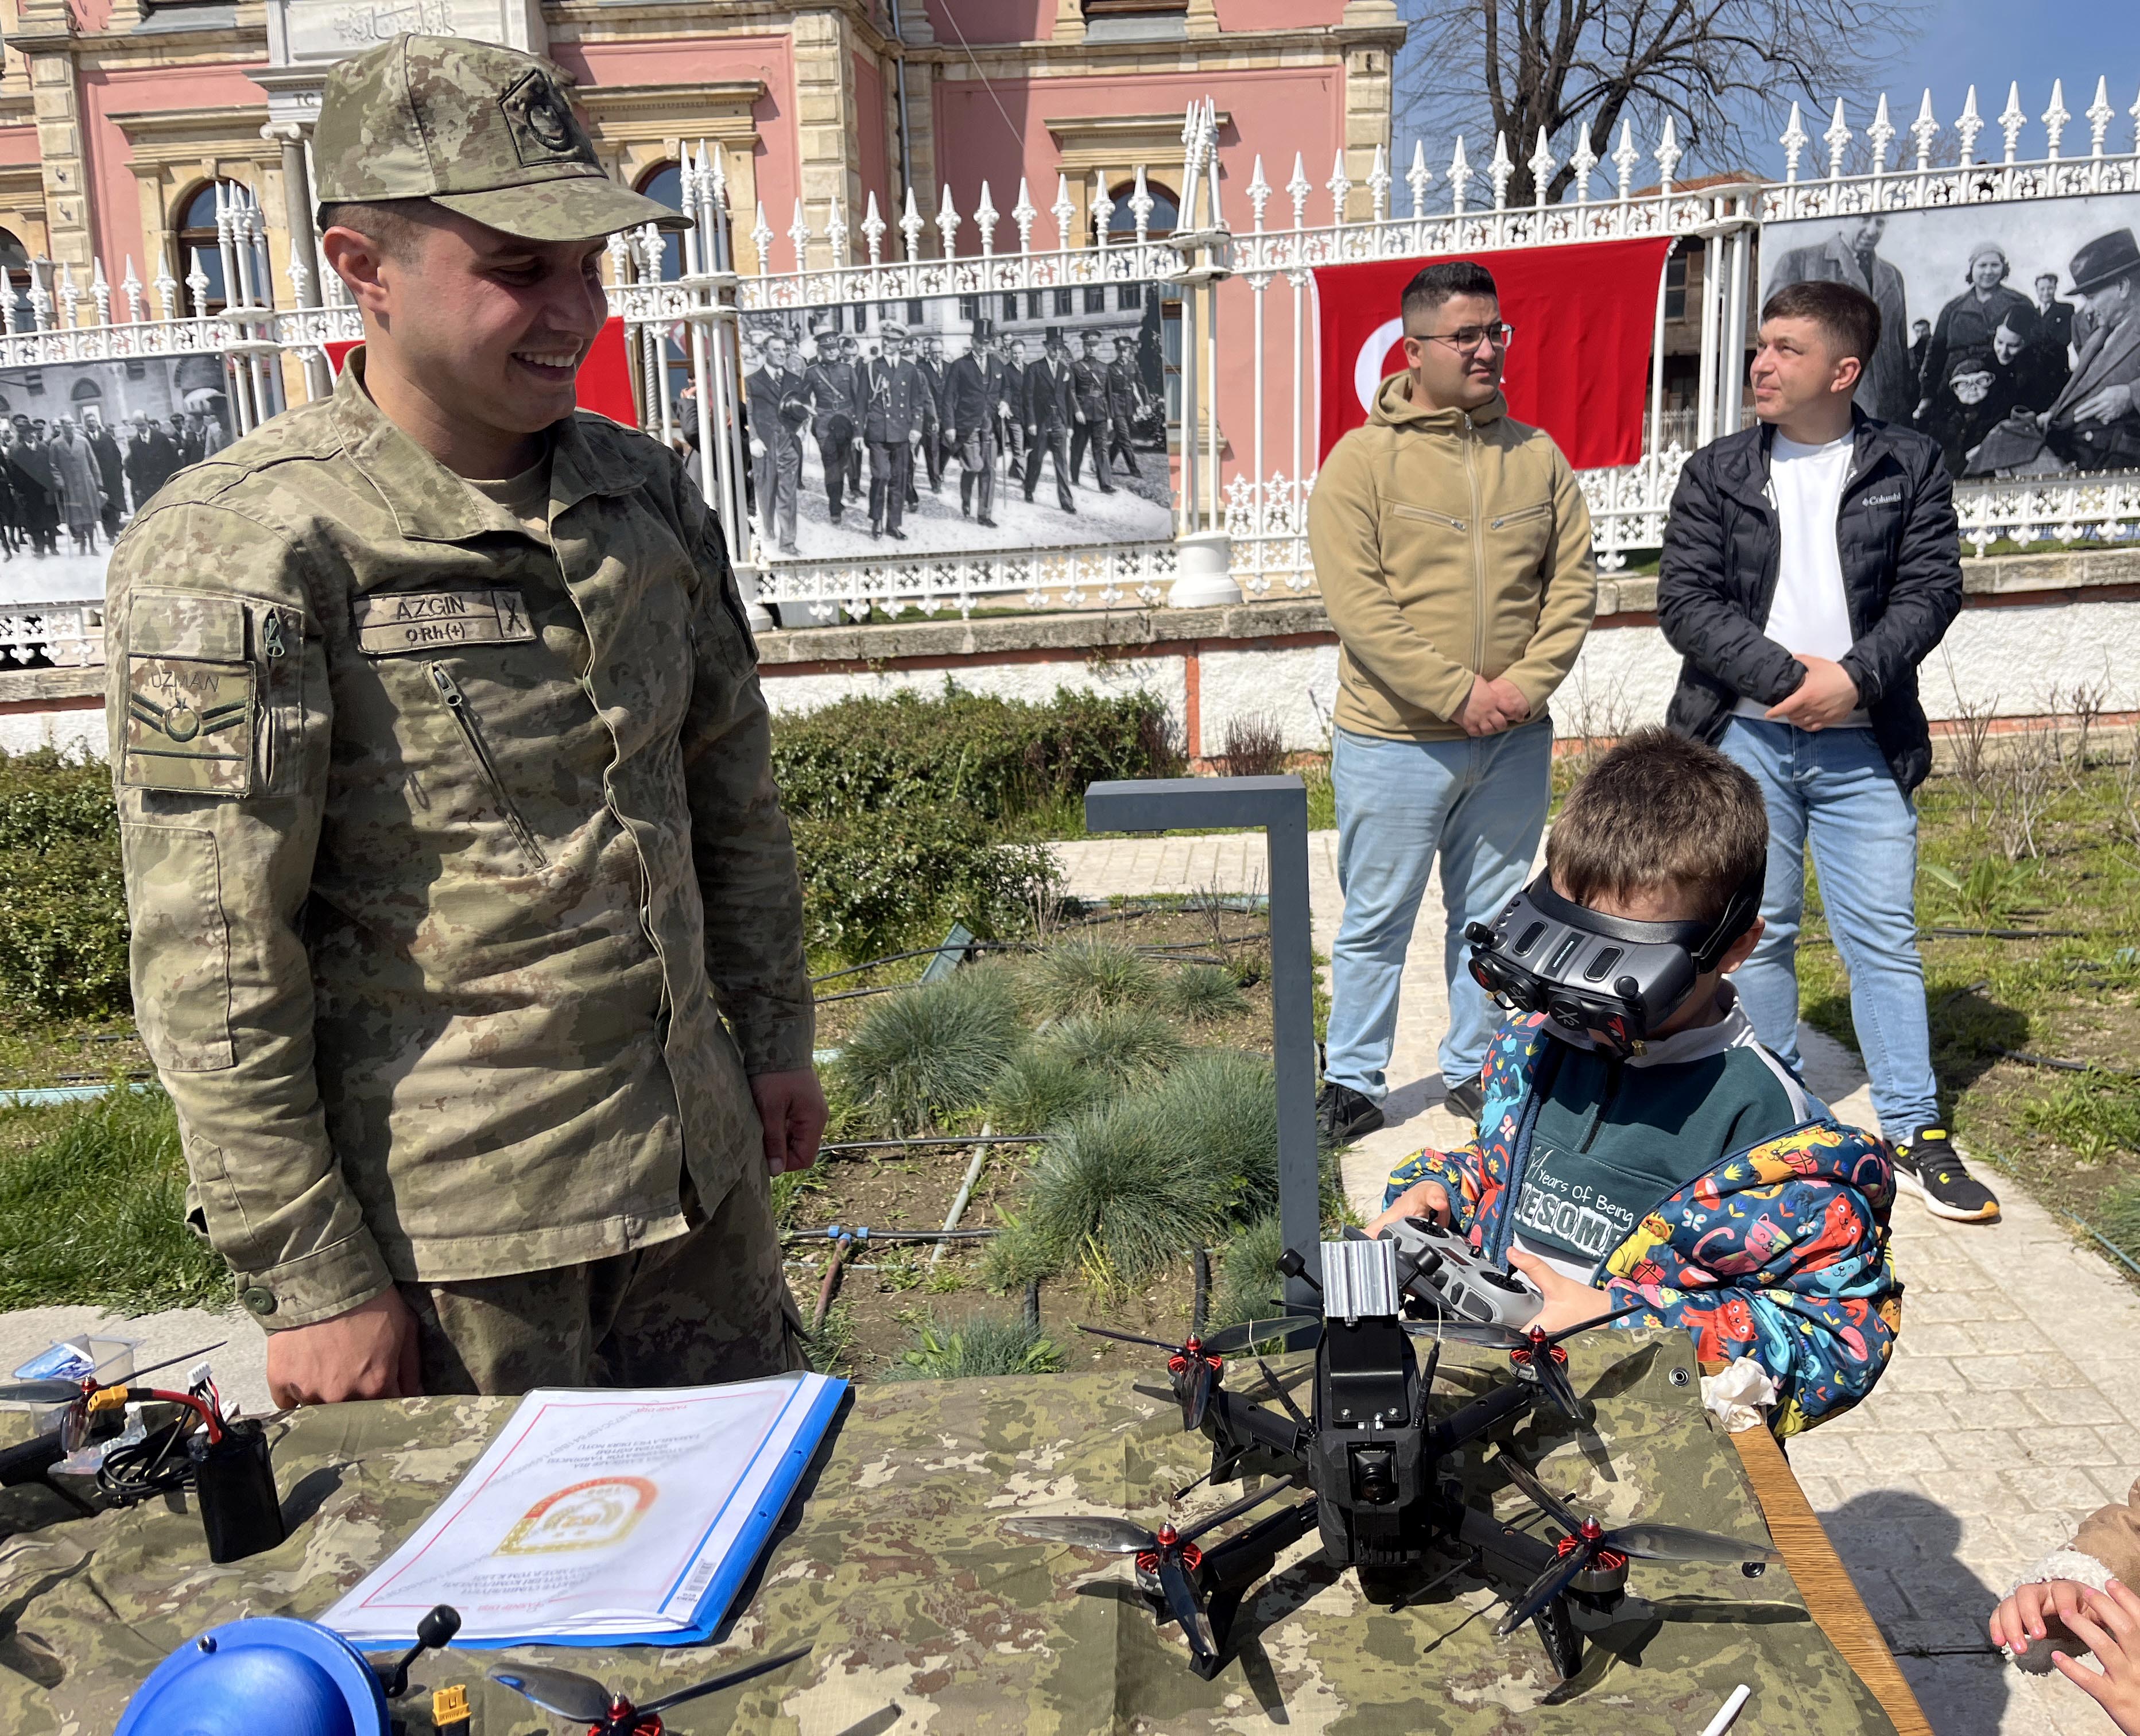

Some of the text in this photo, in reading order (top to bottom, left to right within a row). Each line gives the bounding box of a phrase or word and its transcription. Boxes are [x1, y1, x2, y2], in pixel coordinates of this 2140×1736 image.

[1869, 492, 1902, 506] Columbi
[396, 595, 466, 620] AZGIN
[150, 671, 219, 692] UZMAN
[1538, 1168, 1569, 1192] Years
[1572, 1185, 1593, 1203] Of
[1595, 1194, 1634, 1231] Being
